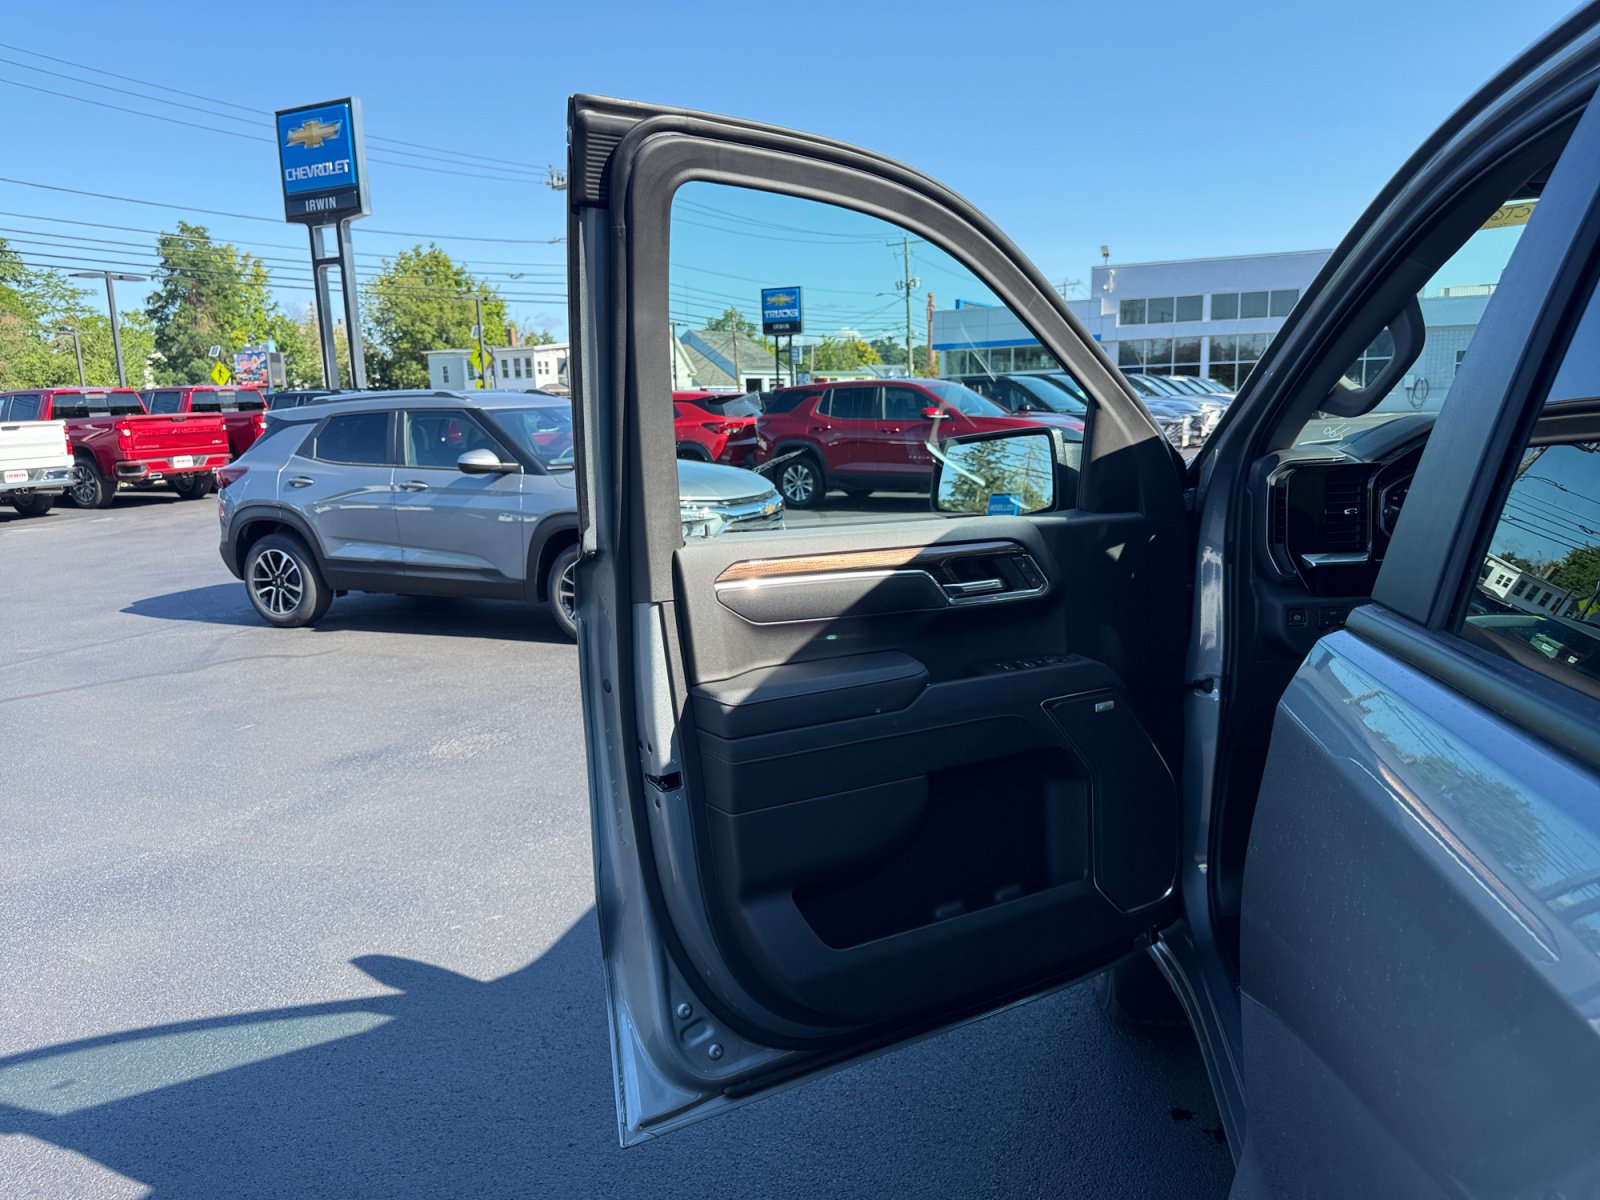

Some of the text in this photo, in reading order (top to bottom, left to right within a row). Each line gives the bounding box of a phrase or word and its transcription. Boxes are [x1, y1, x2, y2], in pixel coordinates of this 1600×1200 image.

[285, 159, 349, 181] CHEVROLET
[305, 196, 337, 212] IRWIN
[764, 309, 798, 319] TRUCKS
